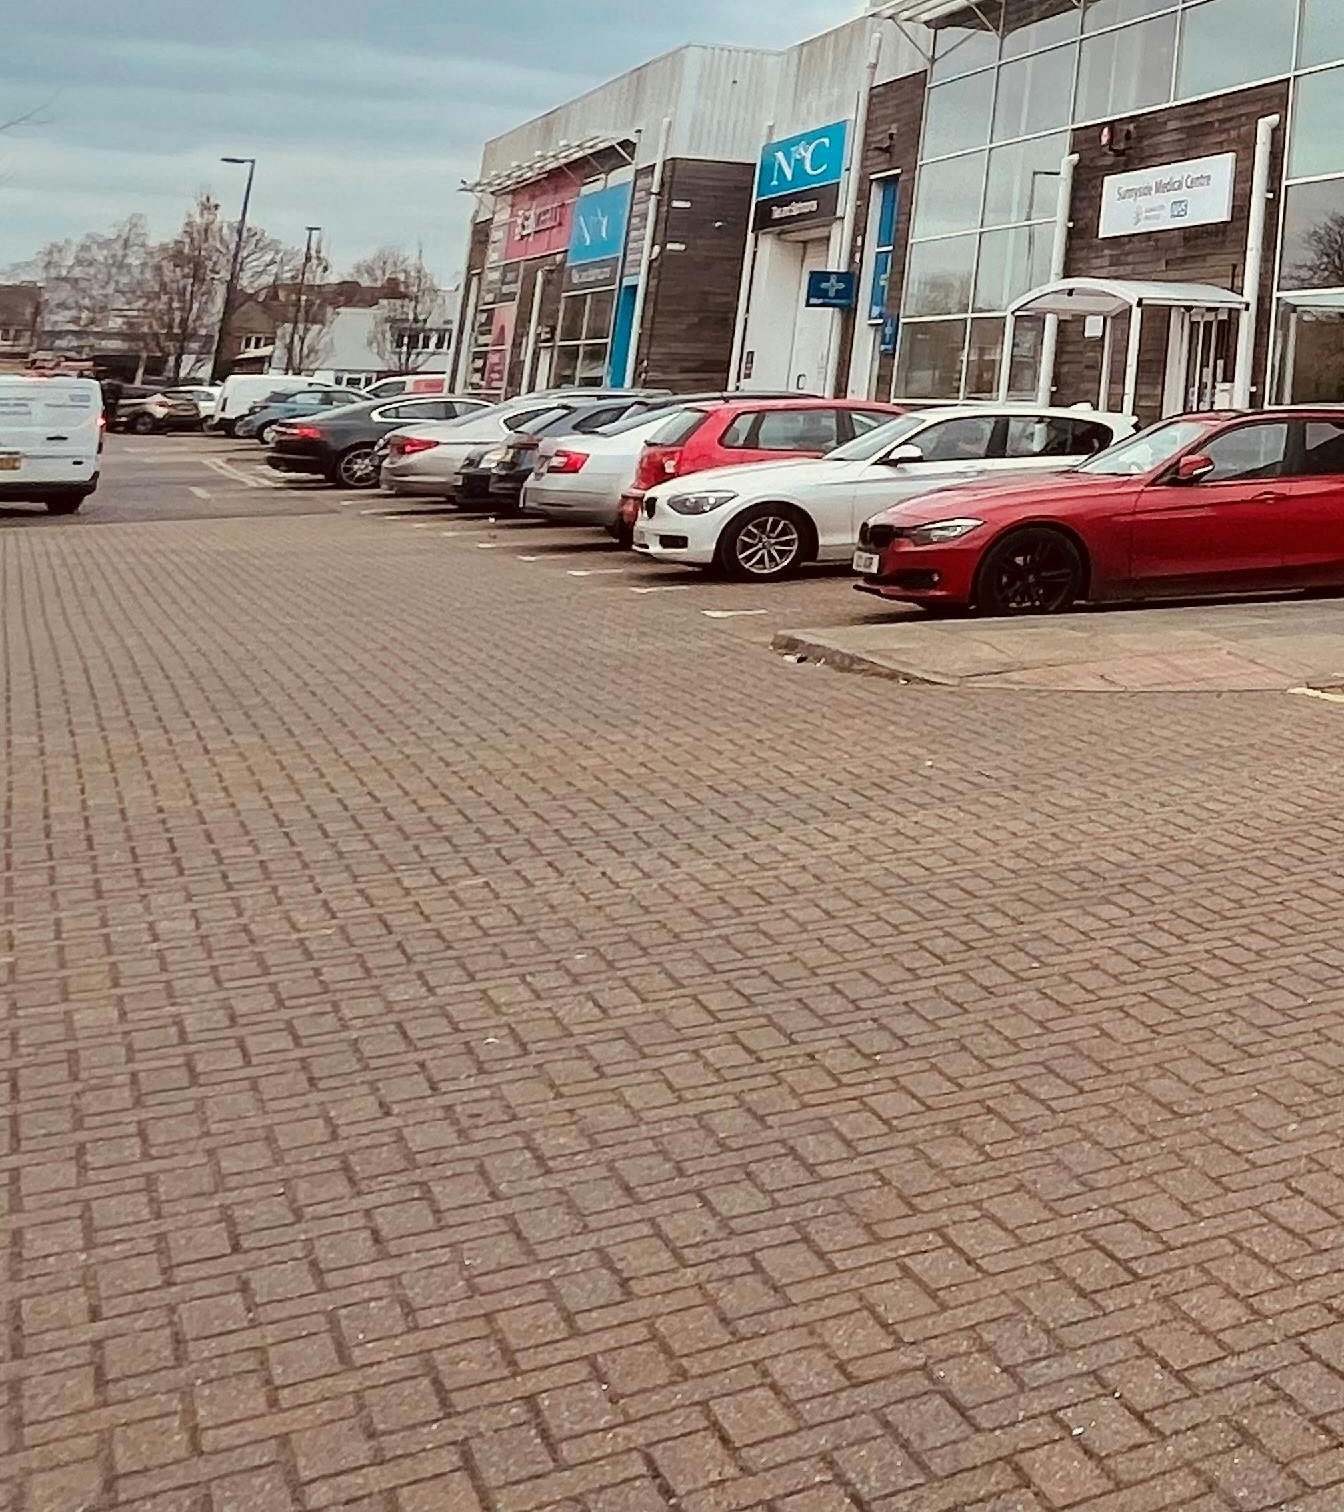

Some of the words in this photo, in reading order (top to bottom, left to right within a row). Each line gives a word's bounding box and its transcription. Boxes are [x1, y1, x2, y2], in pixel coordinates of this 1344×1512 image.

[770, 137, 831, 186] N&C
[1154, 176, 1184, 194] Medical
[1185, 173, 1212, 189] Centre
